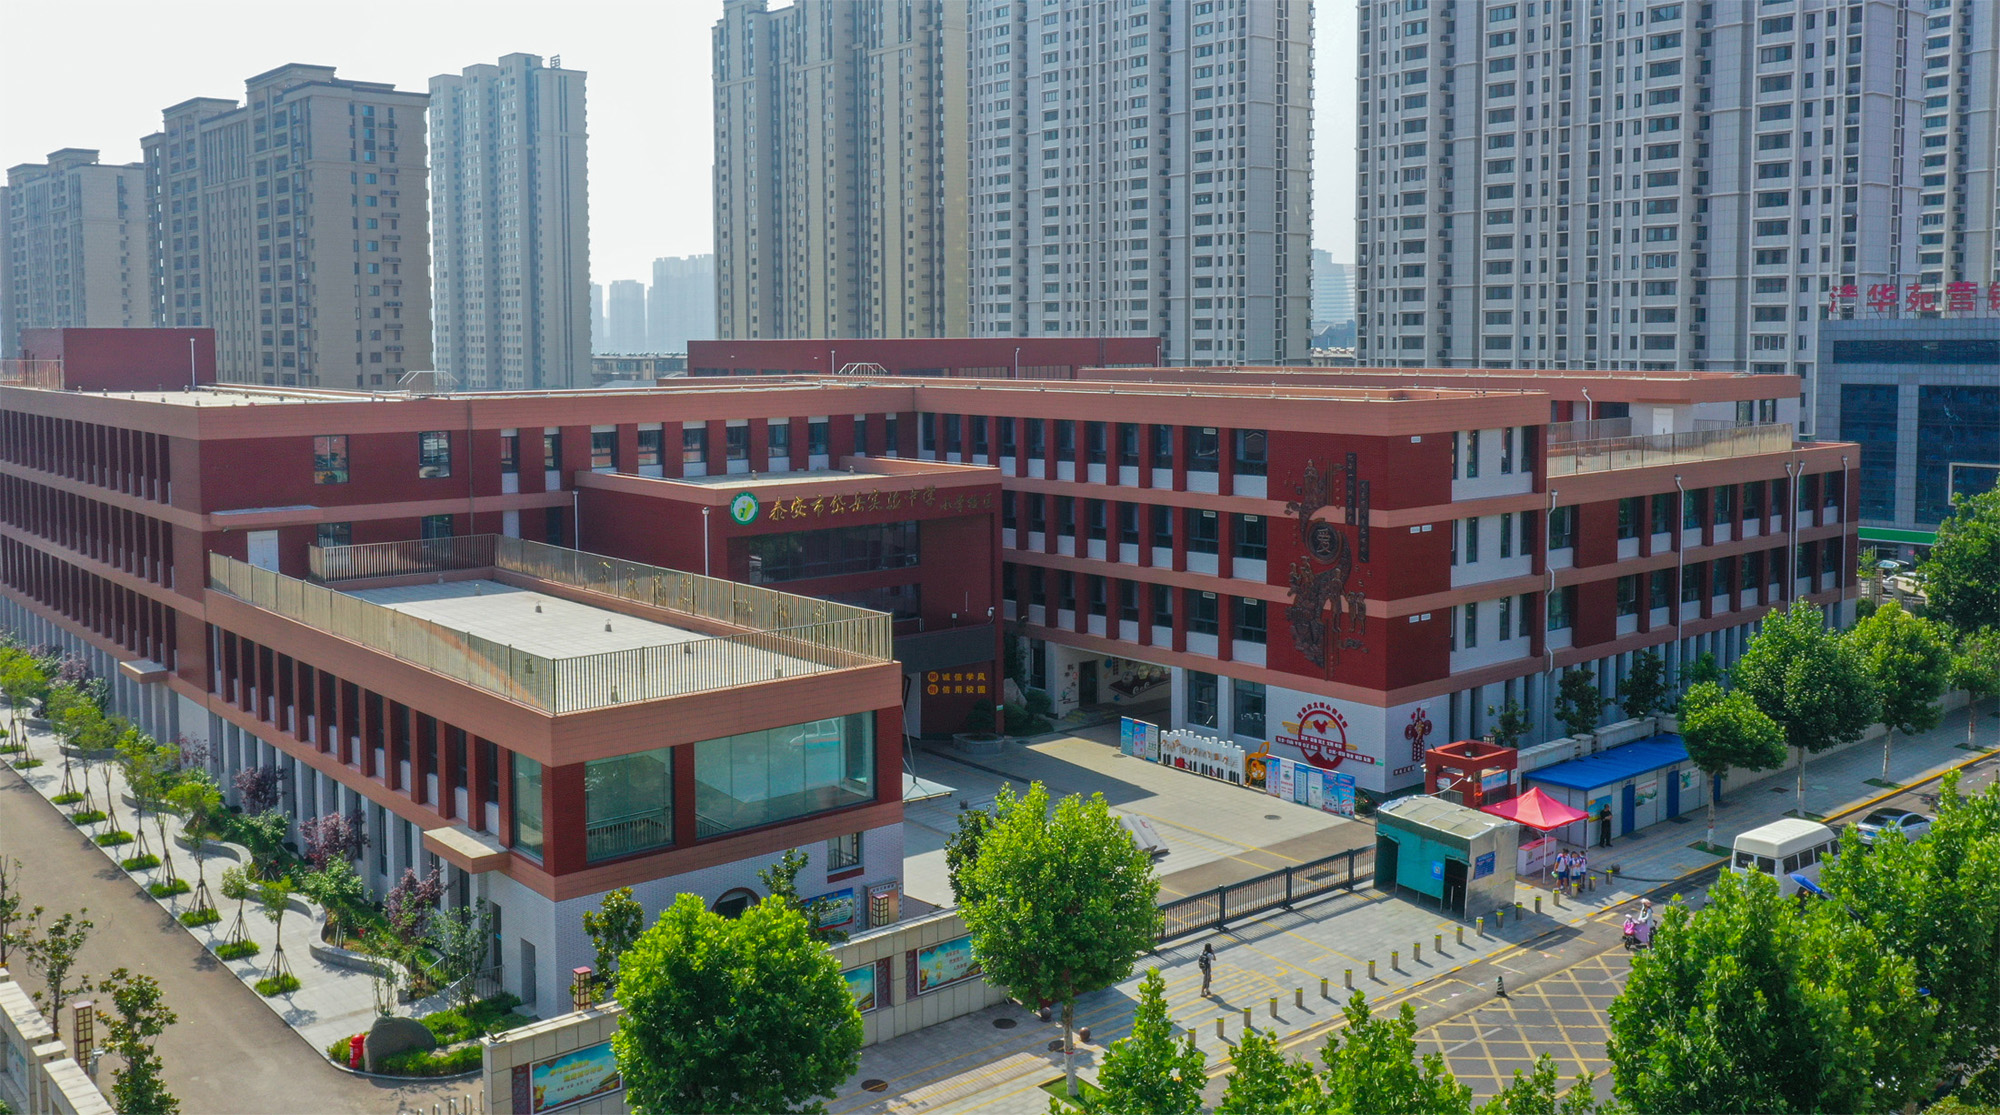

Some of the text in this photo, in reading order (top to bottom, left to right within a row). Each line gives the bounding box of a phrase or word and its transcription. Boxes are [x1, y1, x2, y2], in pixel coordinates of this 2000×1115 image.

[768, 485, 937, 522] 泰安市岱岳实验中学
